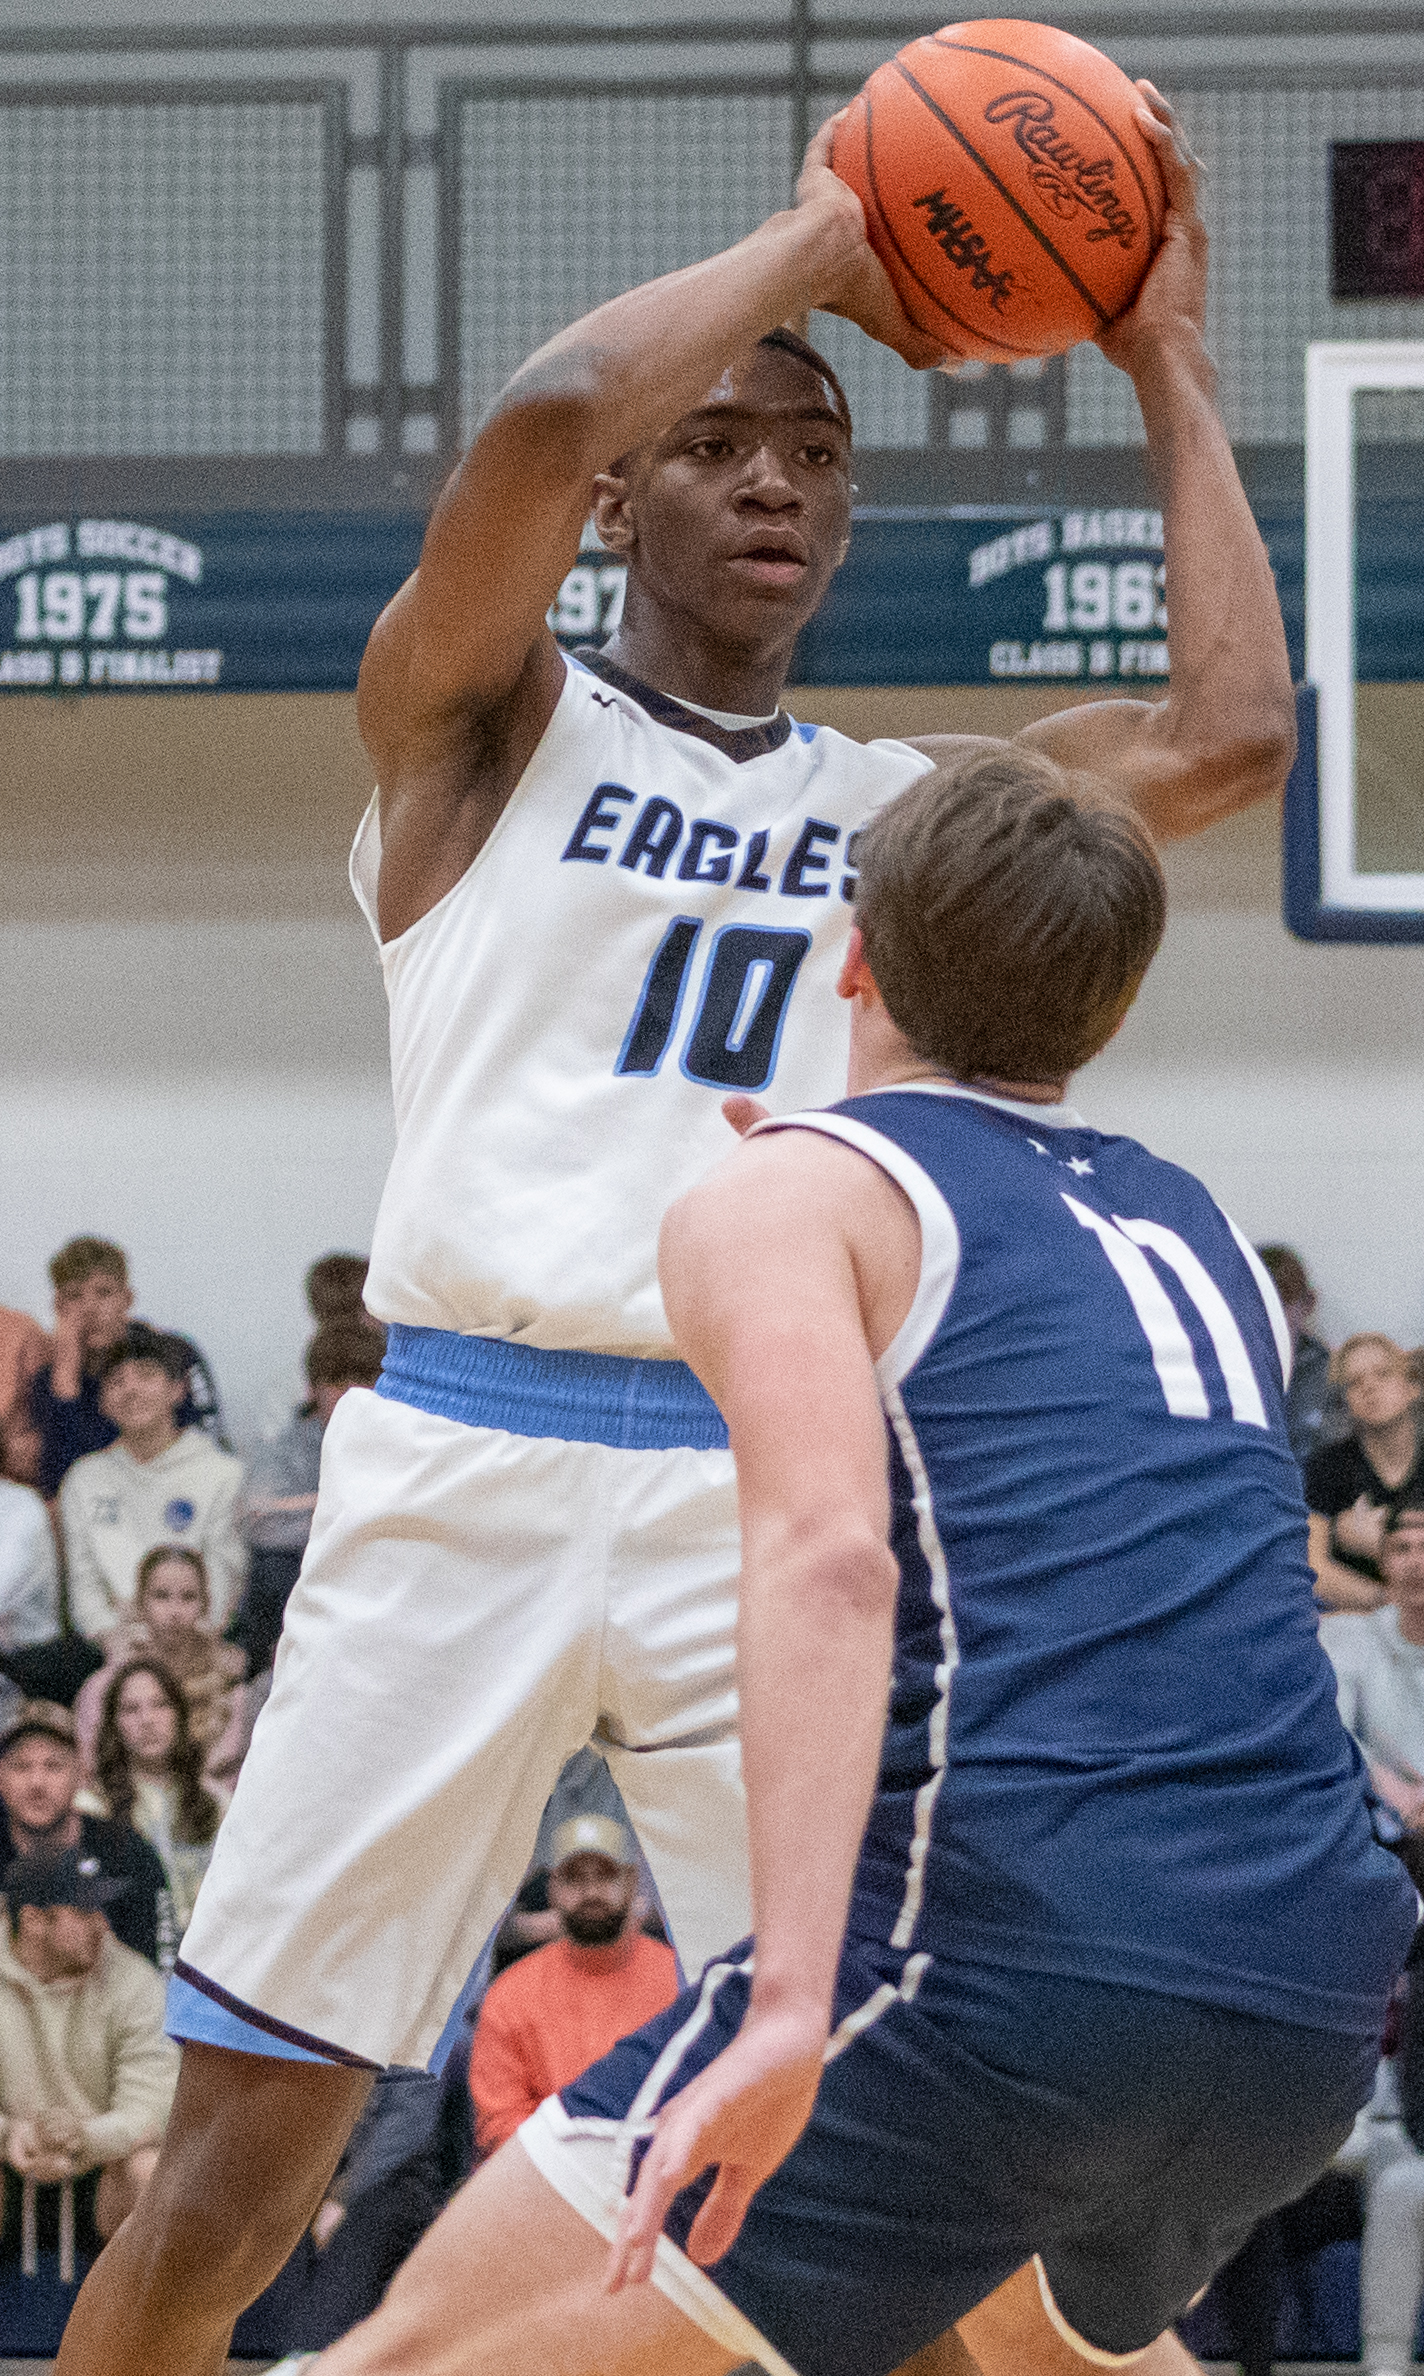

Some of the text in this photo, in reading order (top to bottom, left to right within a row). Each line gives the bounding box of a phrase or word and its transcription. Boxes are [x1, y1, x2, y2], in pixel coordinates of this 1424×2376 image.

[984, 90, 1140, 249] Rawlings
[15, 571, 168, 640] 1975
[989, 640, 1082, 676] CLASS
[613, 915, 813, 1093] 10
[1060, 1191, 1269, 1430] 11
